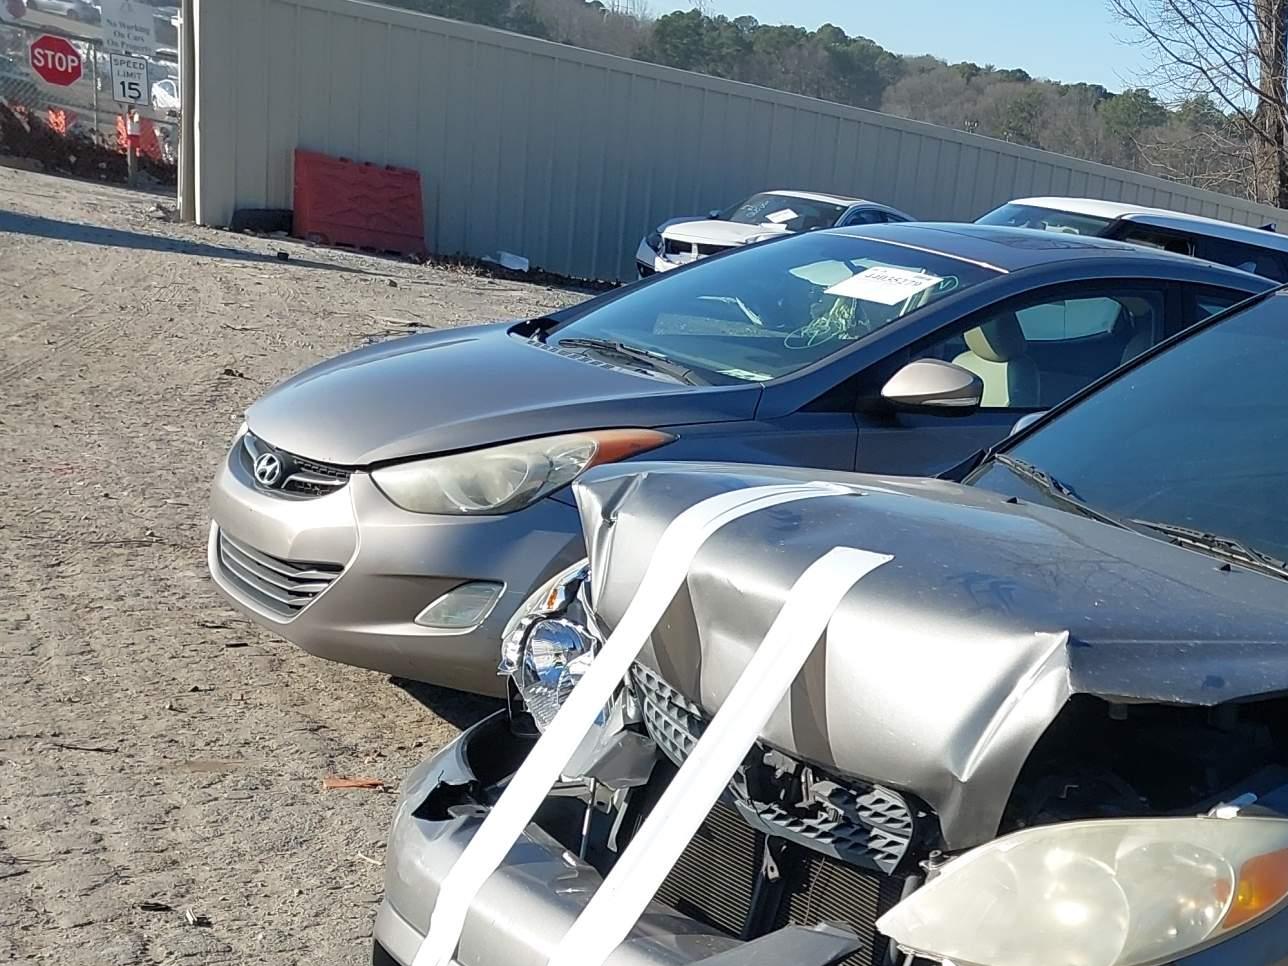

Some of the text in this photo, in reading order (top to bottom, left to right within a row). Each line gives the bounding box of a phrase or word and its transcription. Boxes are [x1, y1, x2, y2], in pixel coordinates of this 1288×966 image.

[33, 47, 79, 73] STOP
[113, 58, 145, 70] SPEED
[117, 70, 143, 79] LIMIT
[119, 80, 142, 100] 15
